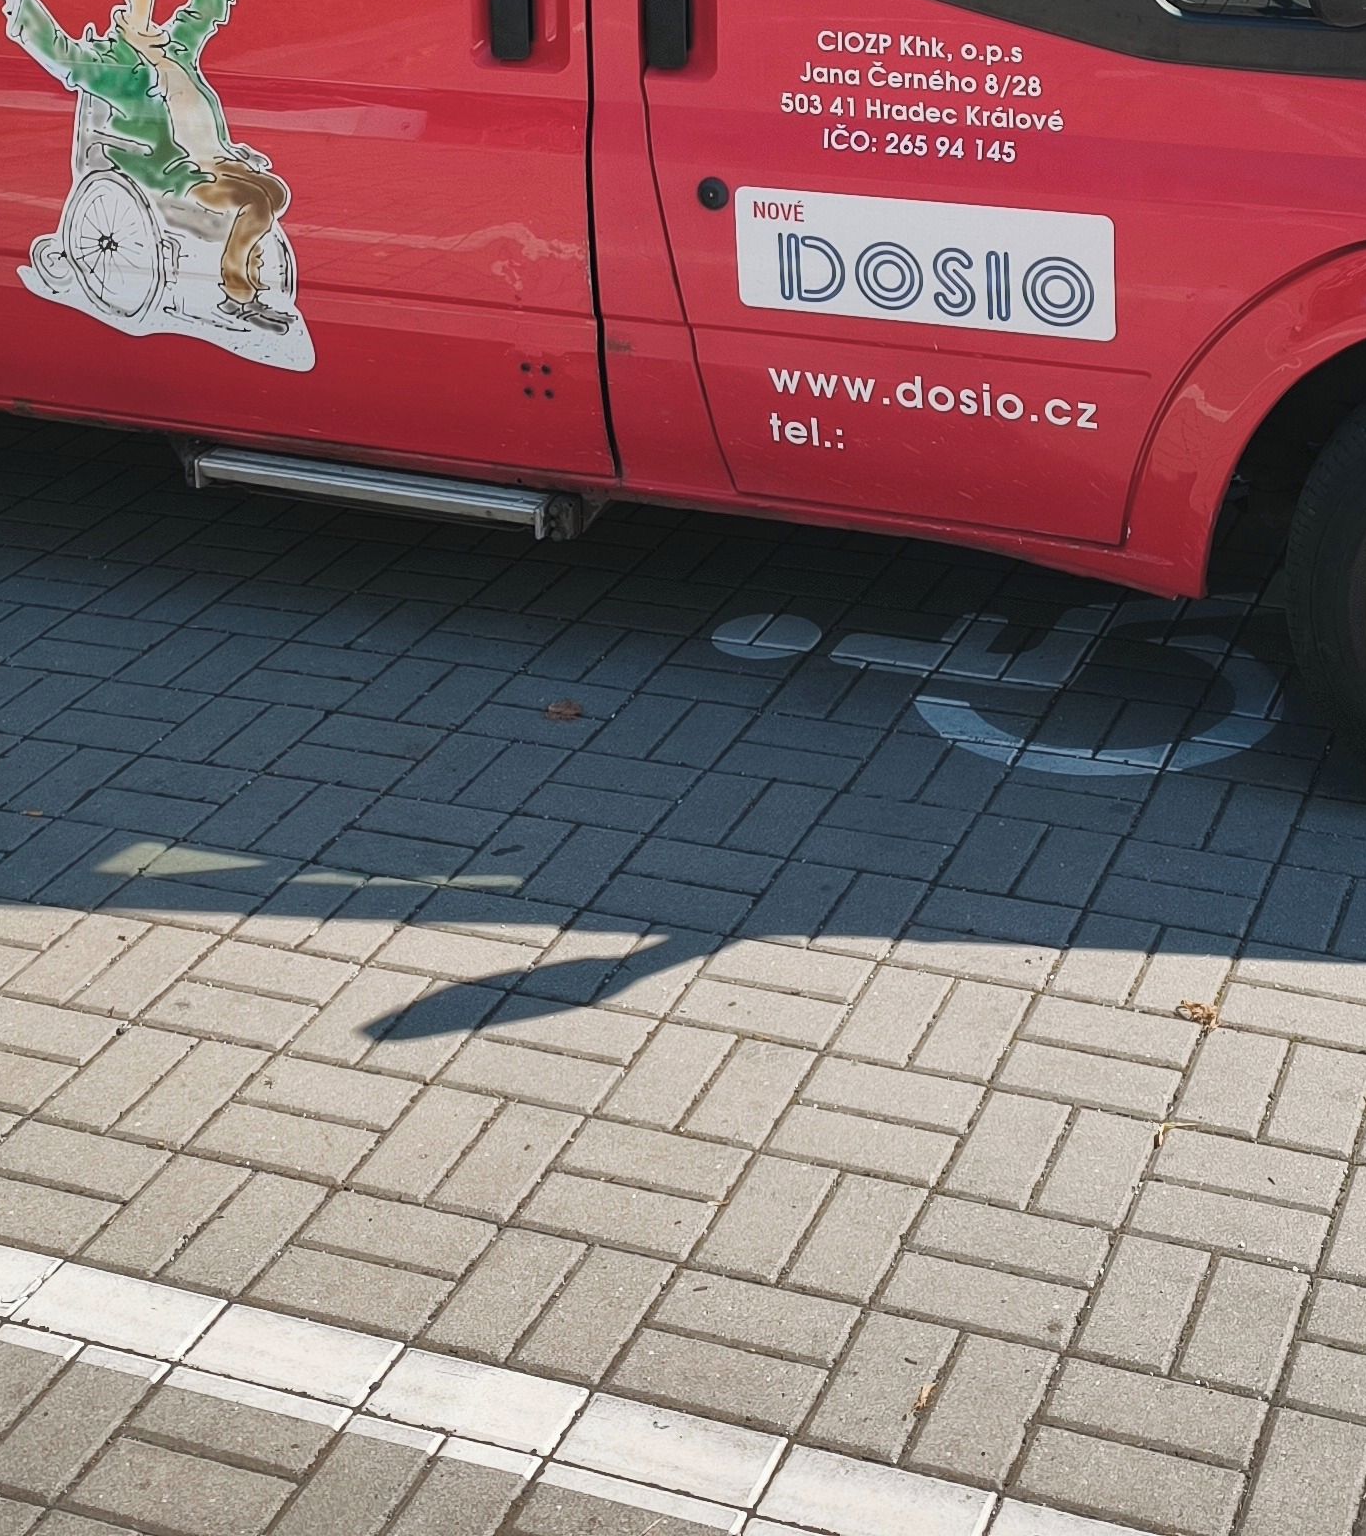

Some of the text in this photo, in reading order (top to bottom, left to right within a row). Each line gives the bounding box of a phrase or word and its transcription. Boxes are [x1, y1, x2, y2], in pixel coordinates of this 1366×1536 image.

[817, 30, 1023, 65] CIOZP Khk, o.p.s
[800, 61, 1042, 98] Jana Černého 8/28
[781, 92, 1064, 132] 503 41 Hradec Králové
[823, 124, 1016, 162] IČO: 265 94 145
[752, 200, 805, 223] NOVÉ
[777, 232, 1095, 327] DOSIO
[768, 367, 1099, 430] www.dosio.cz
[769, 412, 845, 450] tel.:
